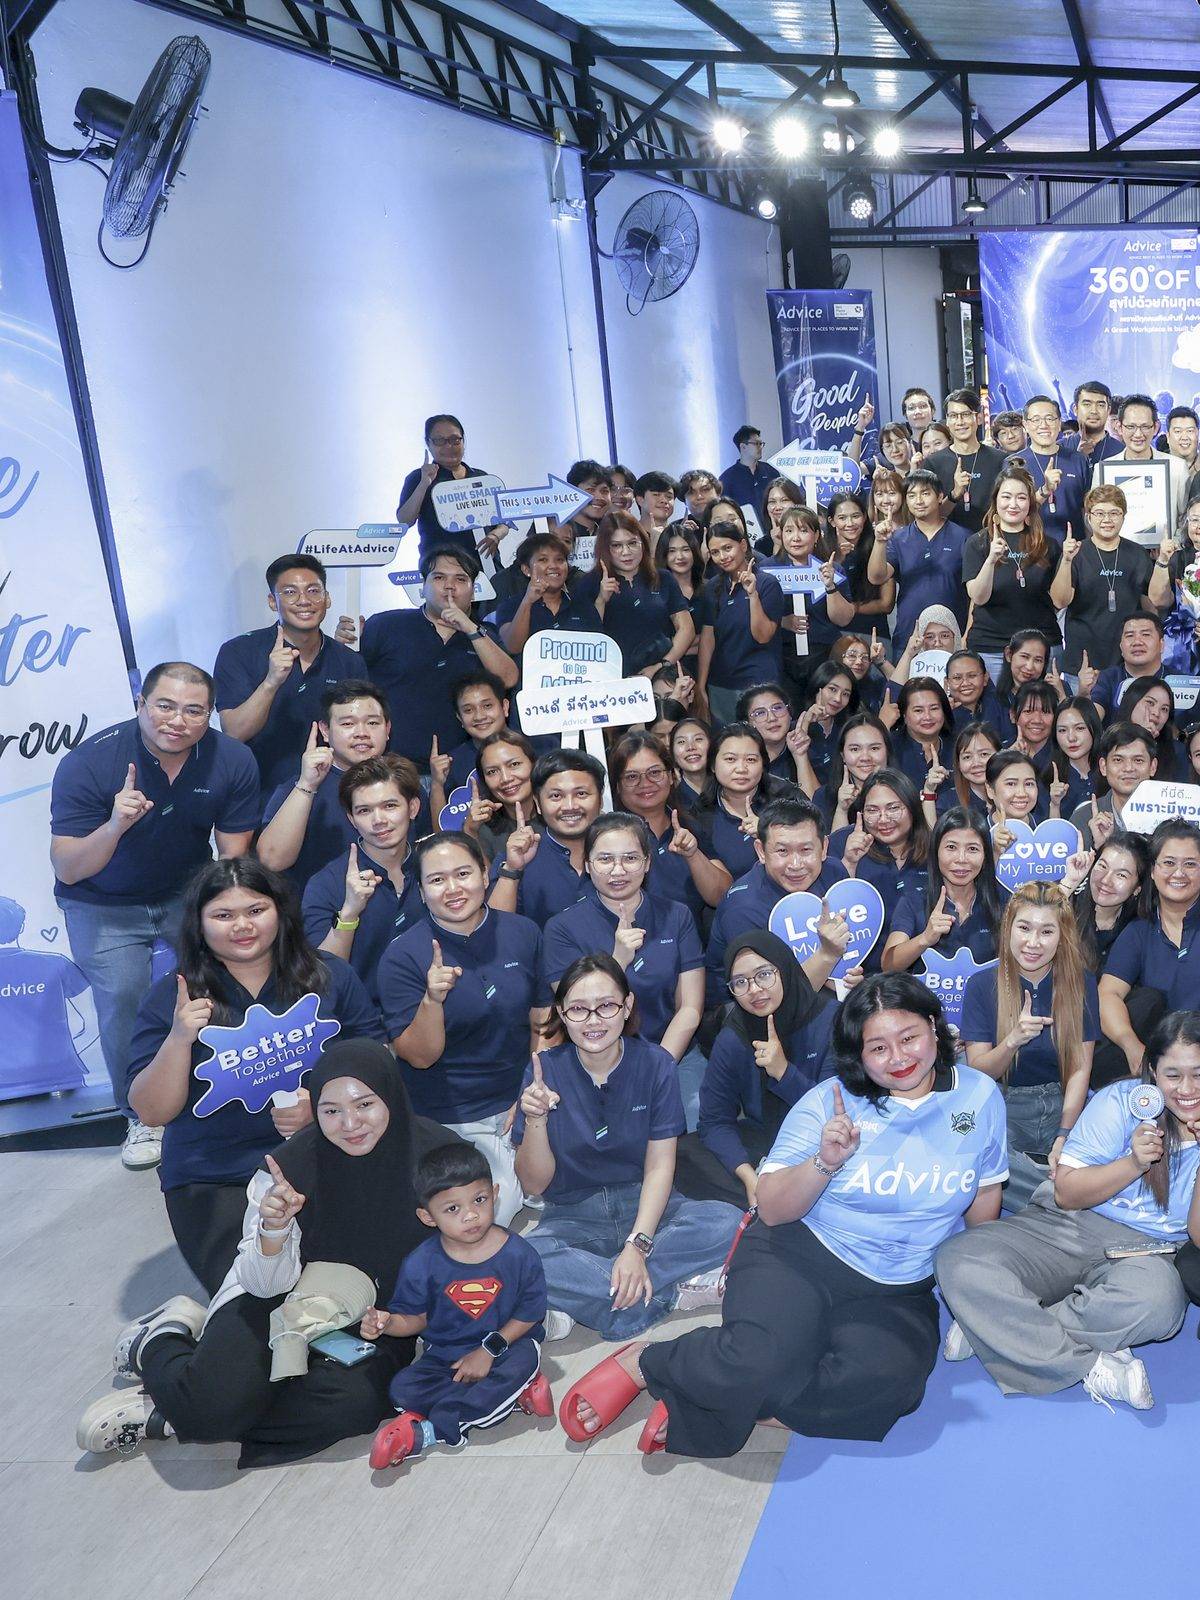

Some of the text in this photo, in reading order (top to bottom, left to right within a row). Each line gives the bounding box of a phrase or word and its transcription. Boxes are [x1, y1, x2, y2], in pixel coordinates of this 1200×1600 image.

[1124, 240, 1161, 252] Advice
[1155, 269, 1190, 290] OF
[777, 305, 823, 319] Advice
[792, 370, 860, 424] Good
[812, 408, 859, 437] People
[436, 486, 502, 505] WORK SMART
[829, 485, 853, 493] Team
[456, 498, 490, 510] LIVE WELL
[501, 493, 580, 508] THIS IS OUR PLACE
[364, 527, 386, 535] Advice
[305, 543, 395, 555] #LifeAtAdvice
[395, 574, 416, 582] Advice
[795, 574, 810, 583] OUR
[1100, 569, 1123, 577] Advice
[540, 637, 607, 662] Pround
[563, 663, 587, 674] to be
[525, 699, 560, 716] งานดี
[562, 718, 588, 727] Advice
[999, 862, 1067, 877] My Team
[792, 941, 818, 960] My
[0, 982, 45, 997] dvice
[925, 973, 965, 991] Bet
[217, 1021, 316, 1071] Better
[231, 1041, 312, 1079] Together
[252, 1070, 280, 1087] Advice
[842, 1161, 976, 1196] Advice
